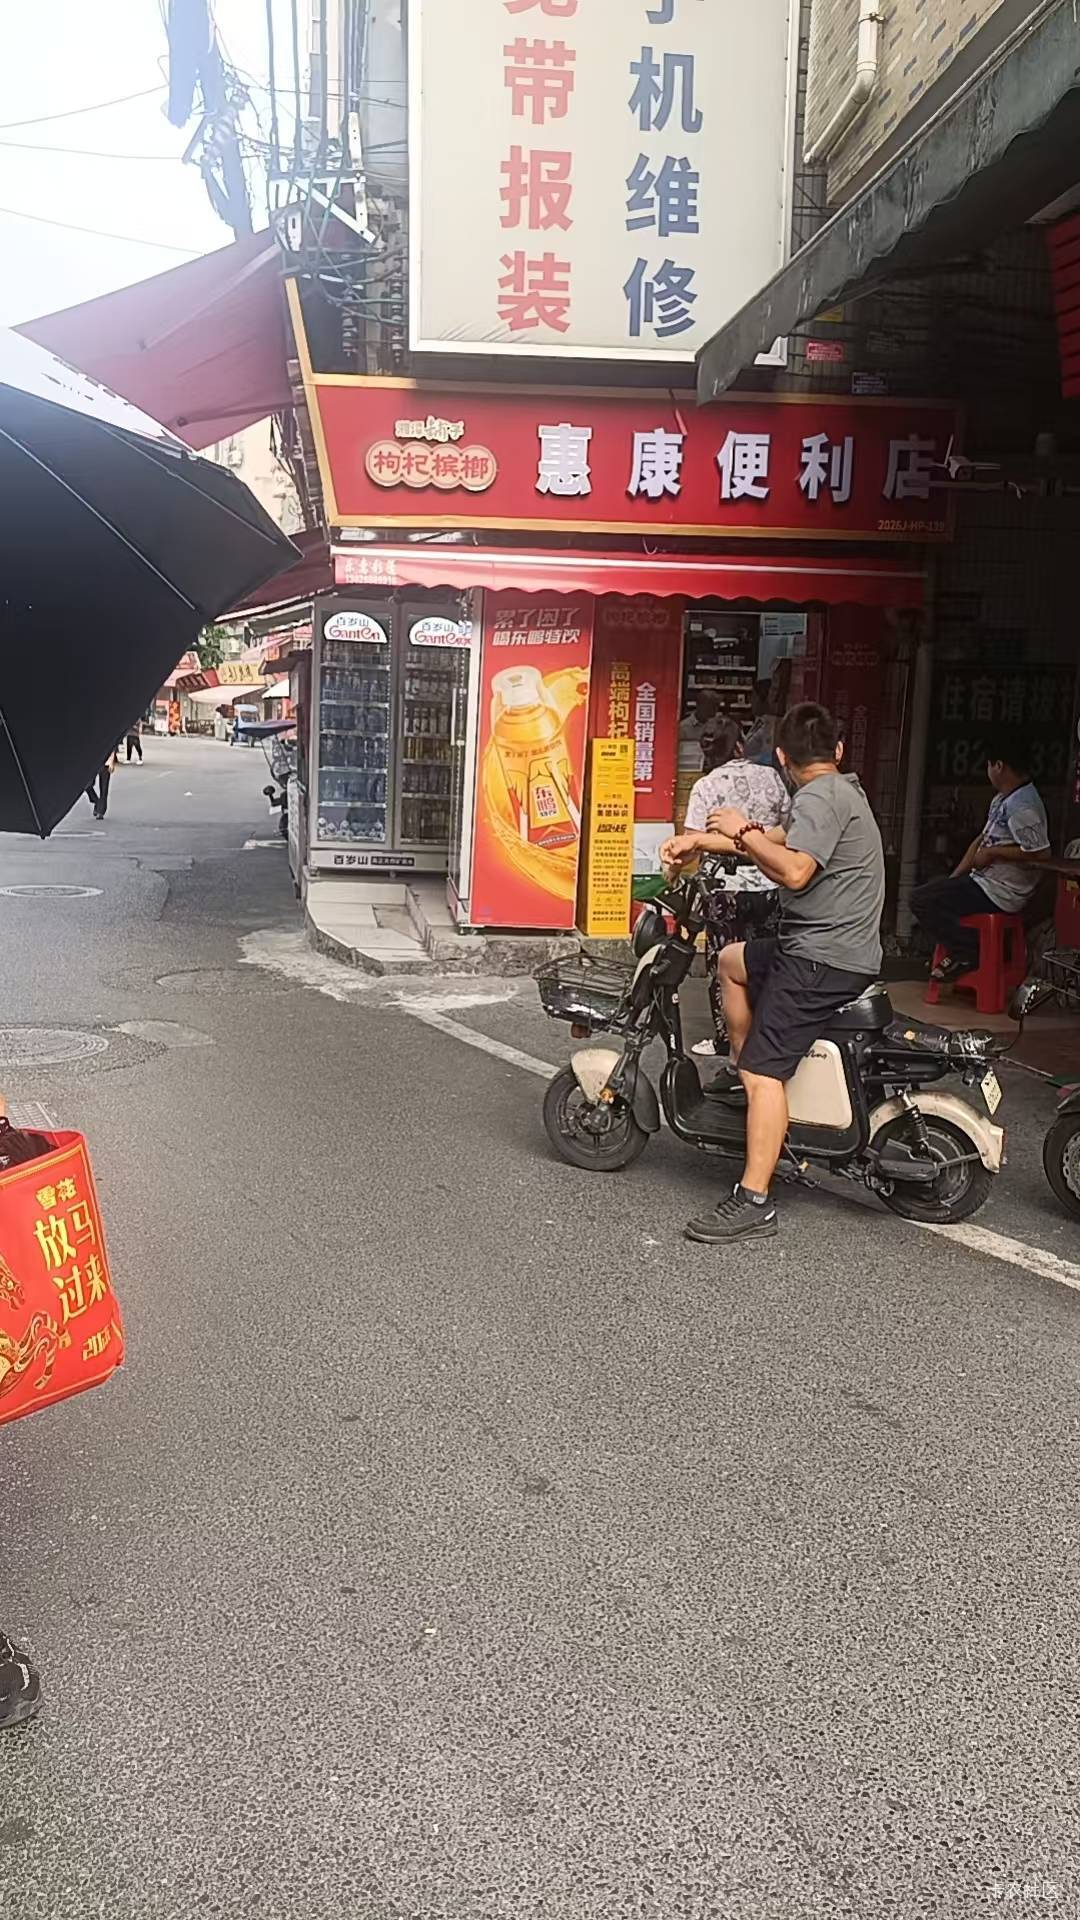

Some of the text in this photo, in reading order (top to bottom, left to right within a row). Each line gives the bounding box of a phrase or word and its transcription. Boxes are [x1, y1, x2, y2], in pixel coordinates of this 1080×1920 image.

[498, 0, 578, 333] 带报装
[623, 0, 703, 338] 机维修
[373, 451, 489, 480] 枸杞槟榔
[535, 423, 936, 503] 惠康便利店
[336, 616, 370, 627] 百岁山
[492, 629, 580, 646] 喝东鹏特饮
[494, 607, 580, 629] 累了困了
[634, 682, 657, 793] 全国销量第一
[334, 854, 369, 866] 百岁山
[36, 1177, 78, 1210] 雪花
[34, 1200, 96, 1271] 放马
[53, 1253, 107, 1325] 过来
